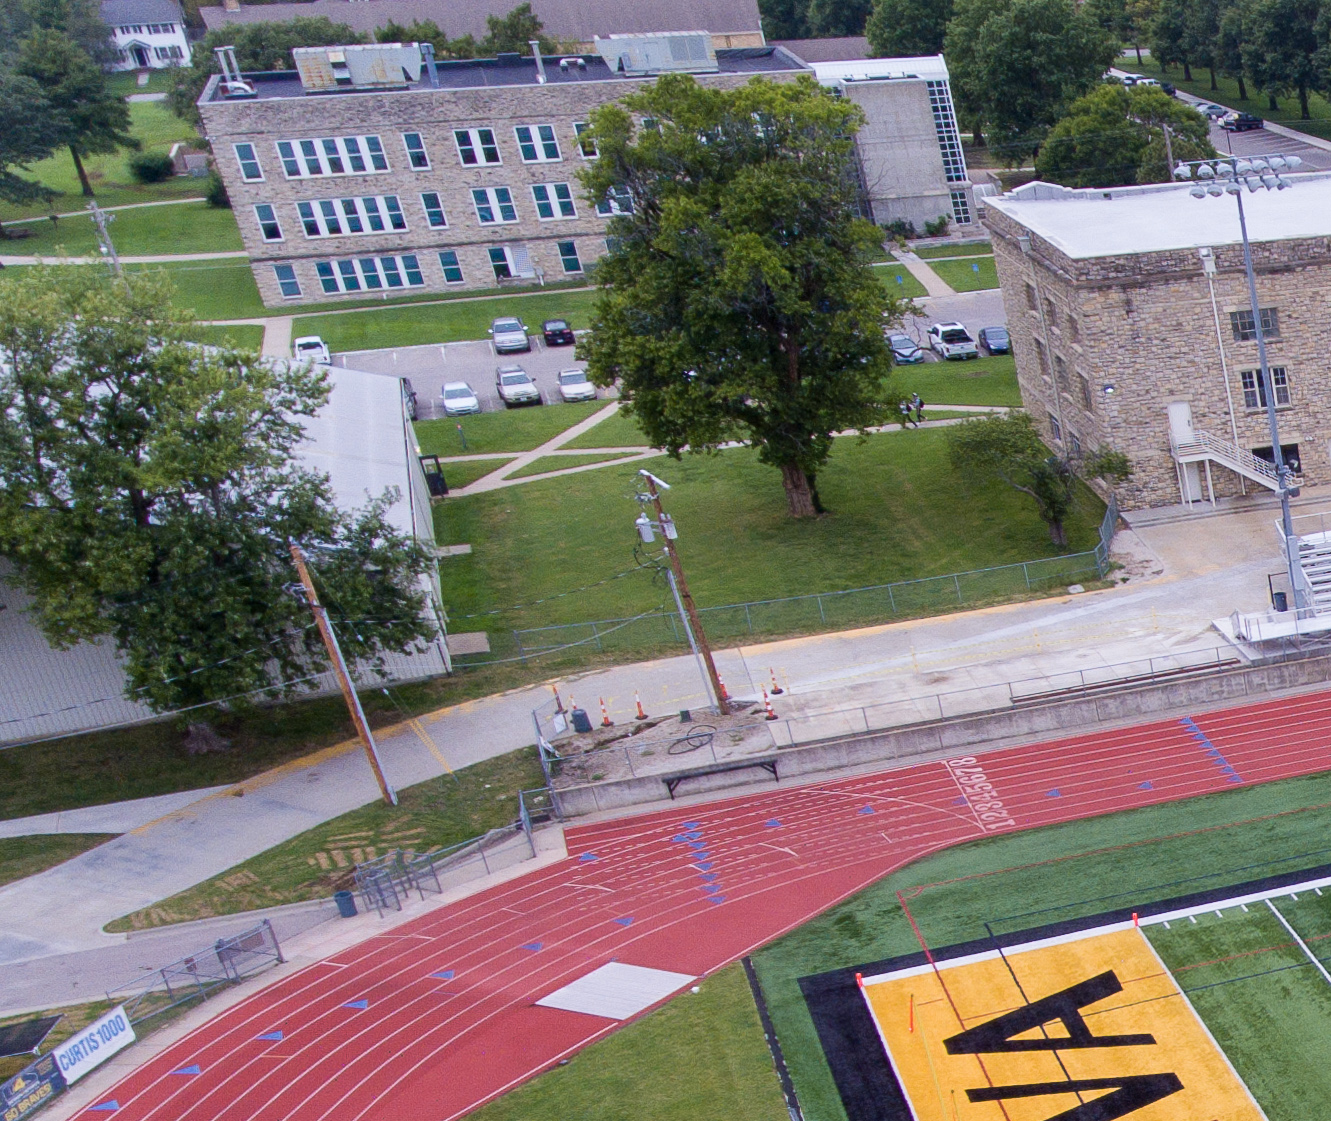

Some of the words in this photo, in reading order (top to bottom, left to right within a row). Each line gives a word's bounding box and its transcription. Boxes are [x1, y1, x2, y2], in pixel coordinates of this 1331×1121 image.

[60, 1032, 100, 1072] CURTIS
[97, 1014, 126, 1044] 1000
[17, 1082, 52, 1112] BRAVES
